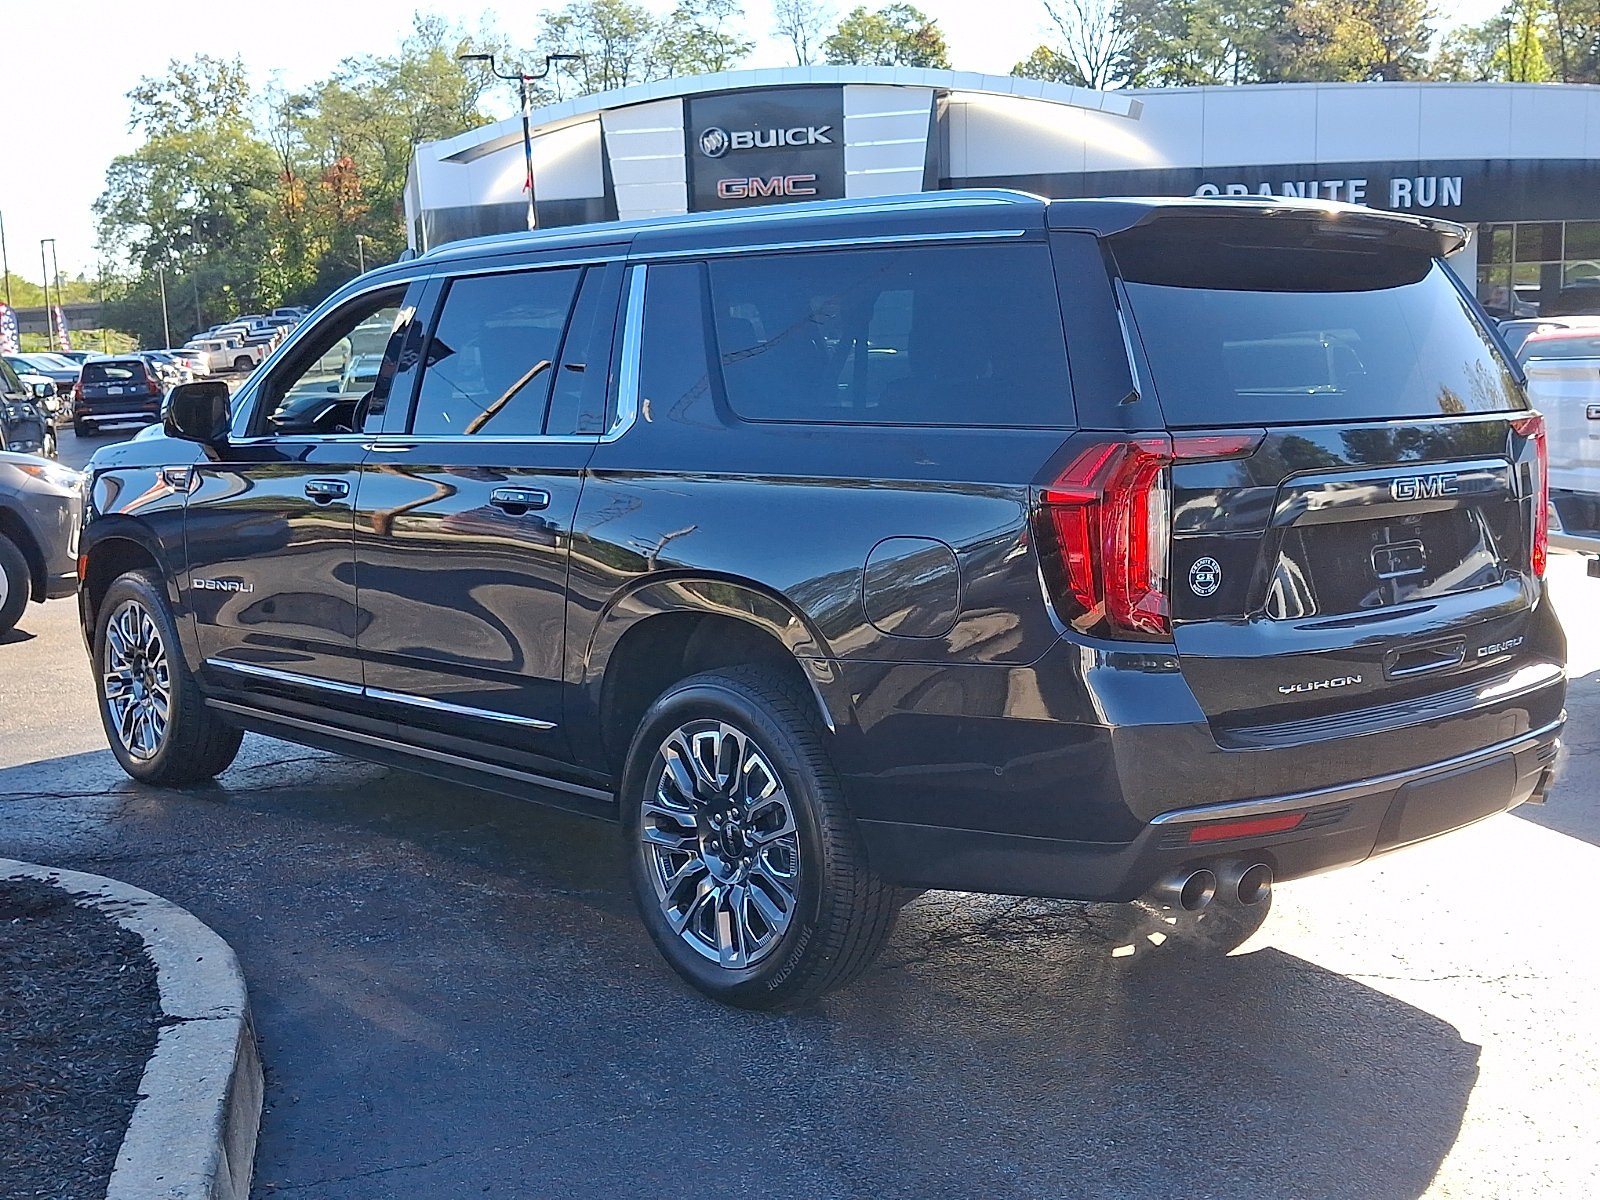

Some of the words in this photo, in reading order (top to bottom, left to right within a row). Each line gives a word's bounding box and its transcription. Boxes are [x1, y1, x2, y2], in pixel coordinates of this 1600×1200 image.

[730, 125, 832, 150] BUICK
[717, 174, 816, 199] GMC
[1390, 176, 1463, 209] RUN
[1391, 473, 1459, 502] GMC
[192, 578, 255, 593] DENALI
[1477, 636, 1524, 657] DENALI
[1278, 674, 1362, 695] YUKON
